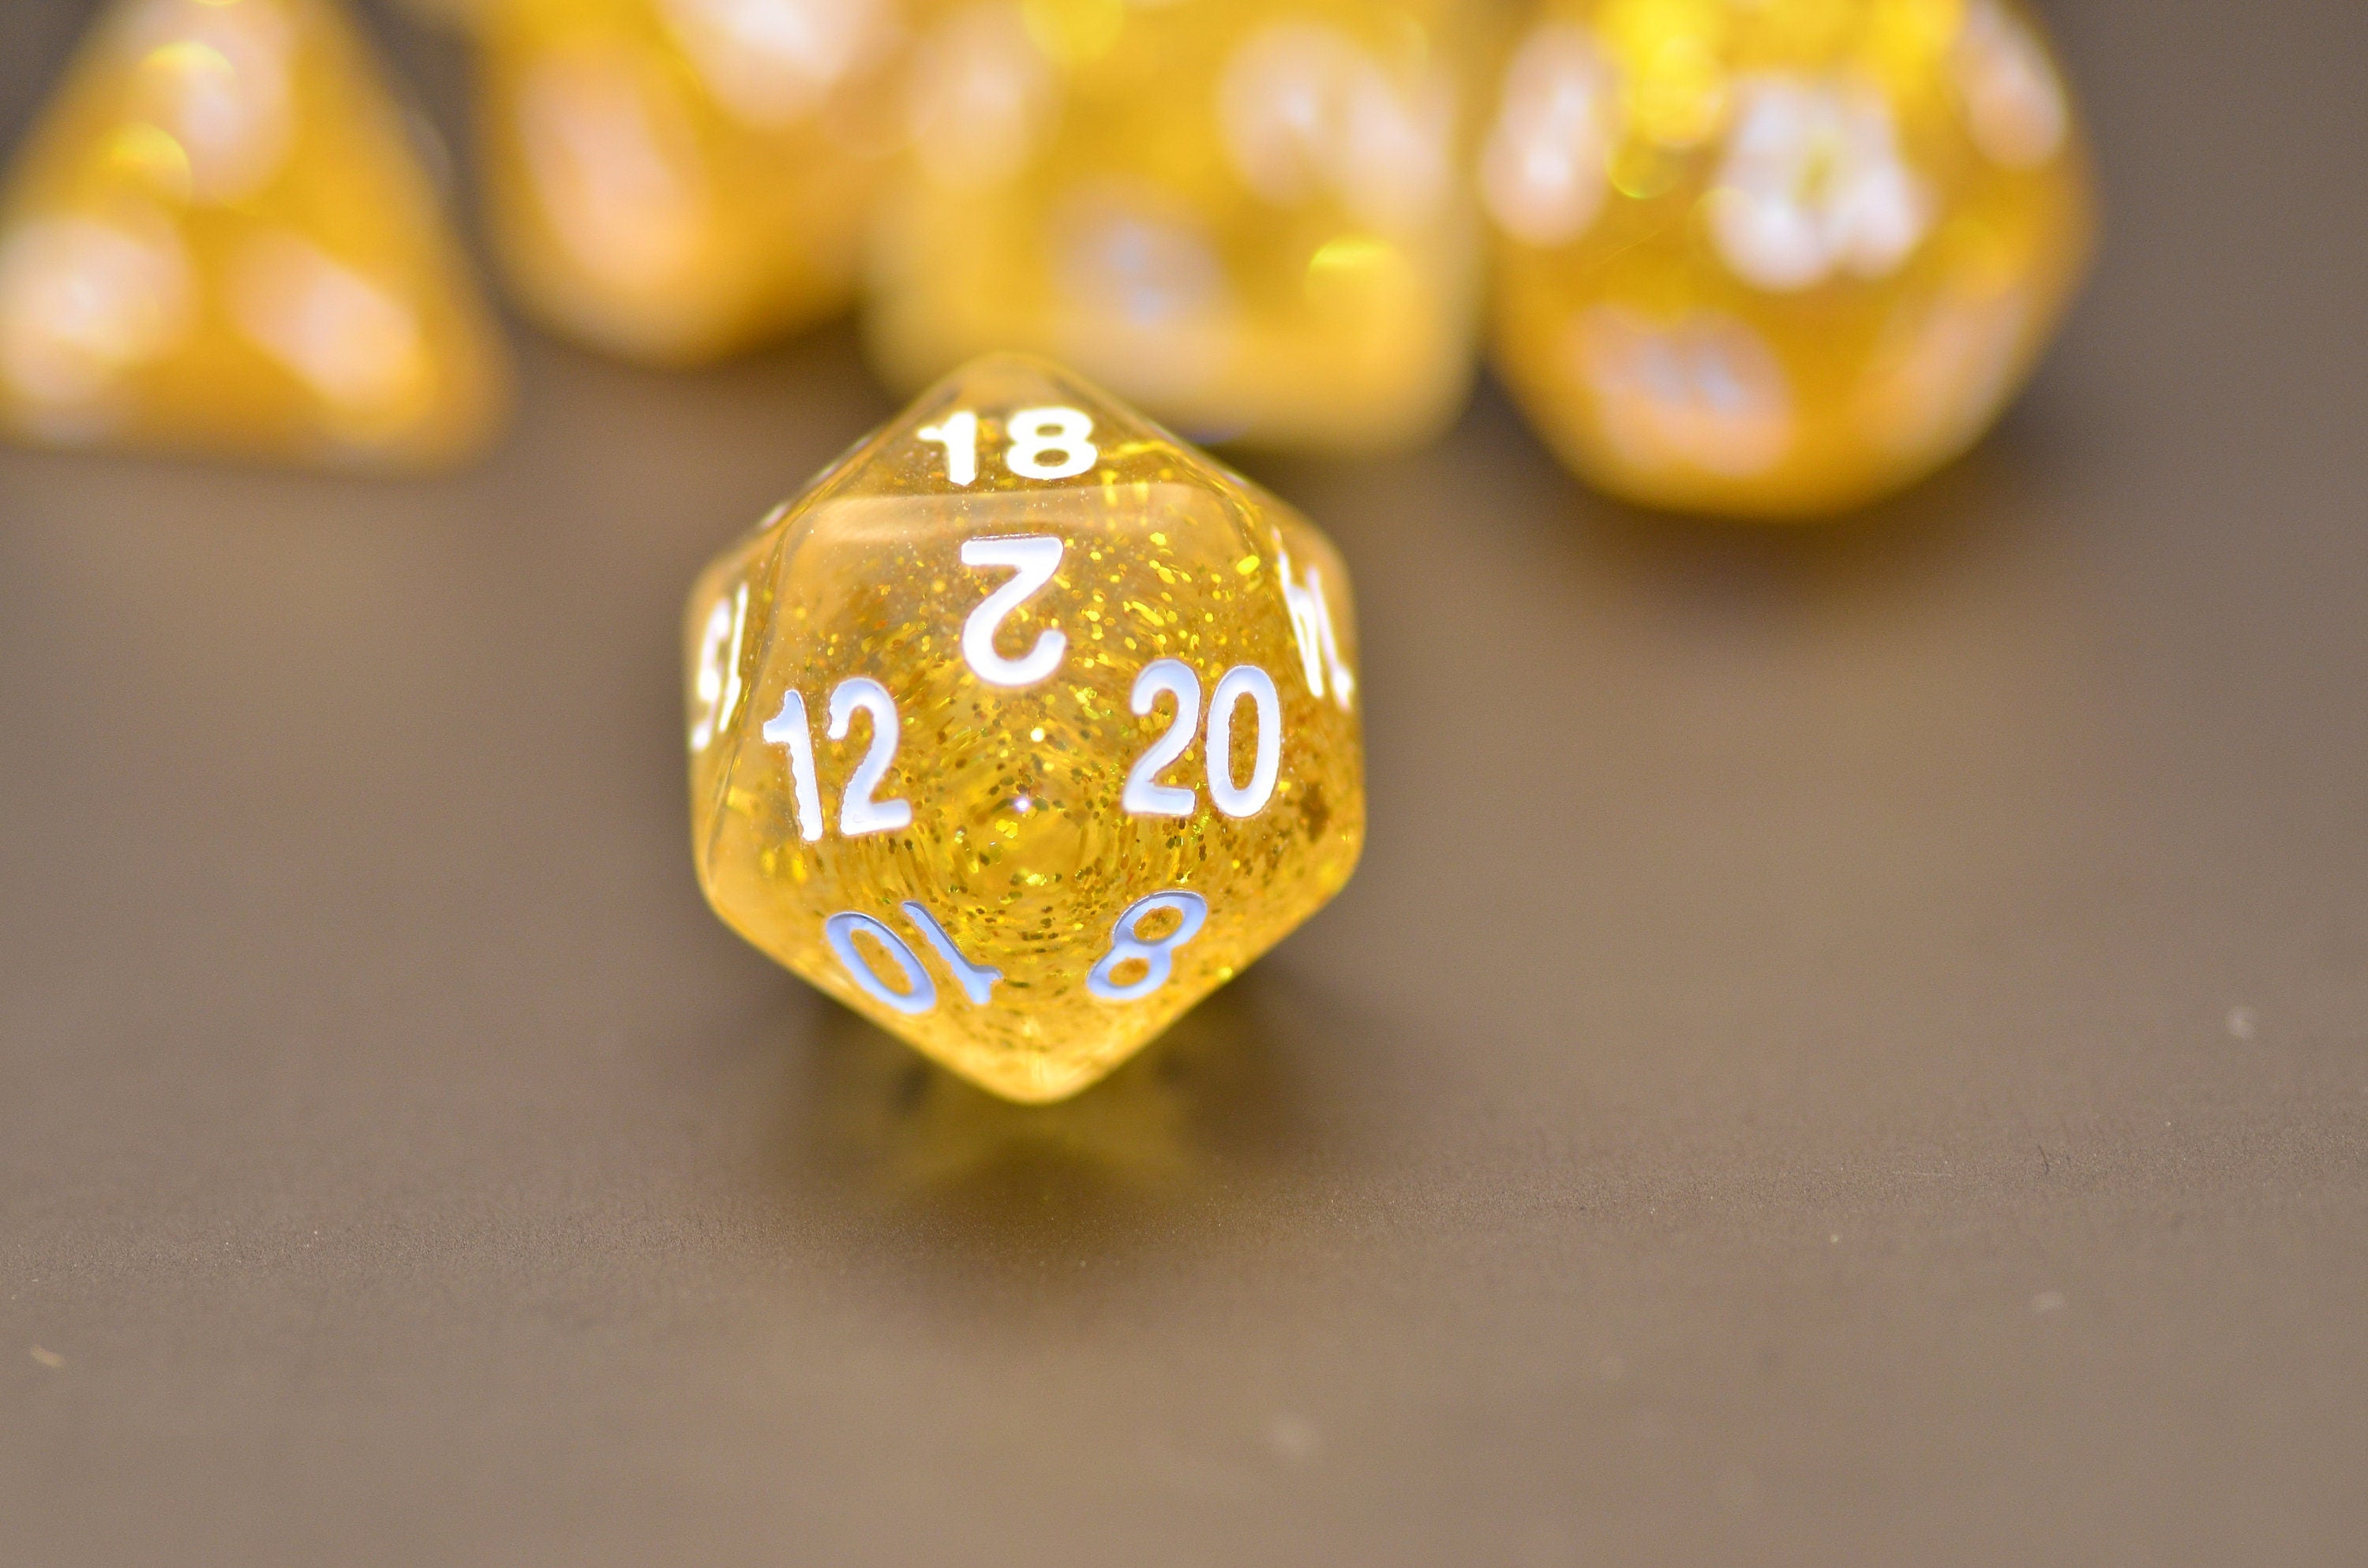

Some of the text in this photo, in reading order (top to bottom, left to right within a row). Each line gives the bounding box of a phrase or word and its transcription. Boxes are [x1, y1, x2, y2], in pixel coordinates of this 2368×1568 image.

[916, 406, 1099, 487] 18
[960, 533, 1068, 687] 2
[762, 677, 912, 842] 12
[1121, 658, 1286, 818] 20
[826, 900, 1003, 1016] 10
[1086, 890, 1208, 1001] 8
